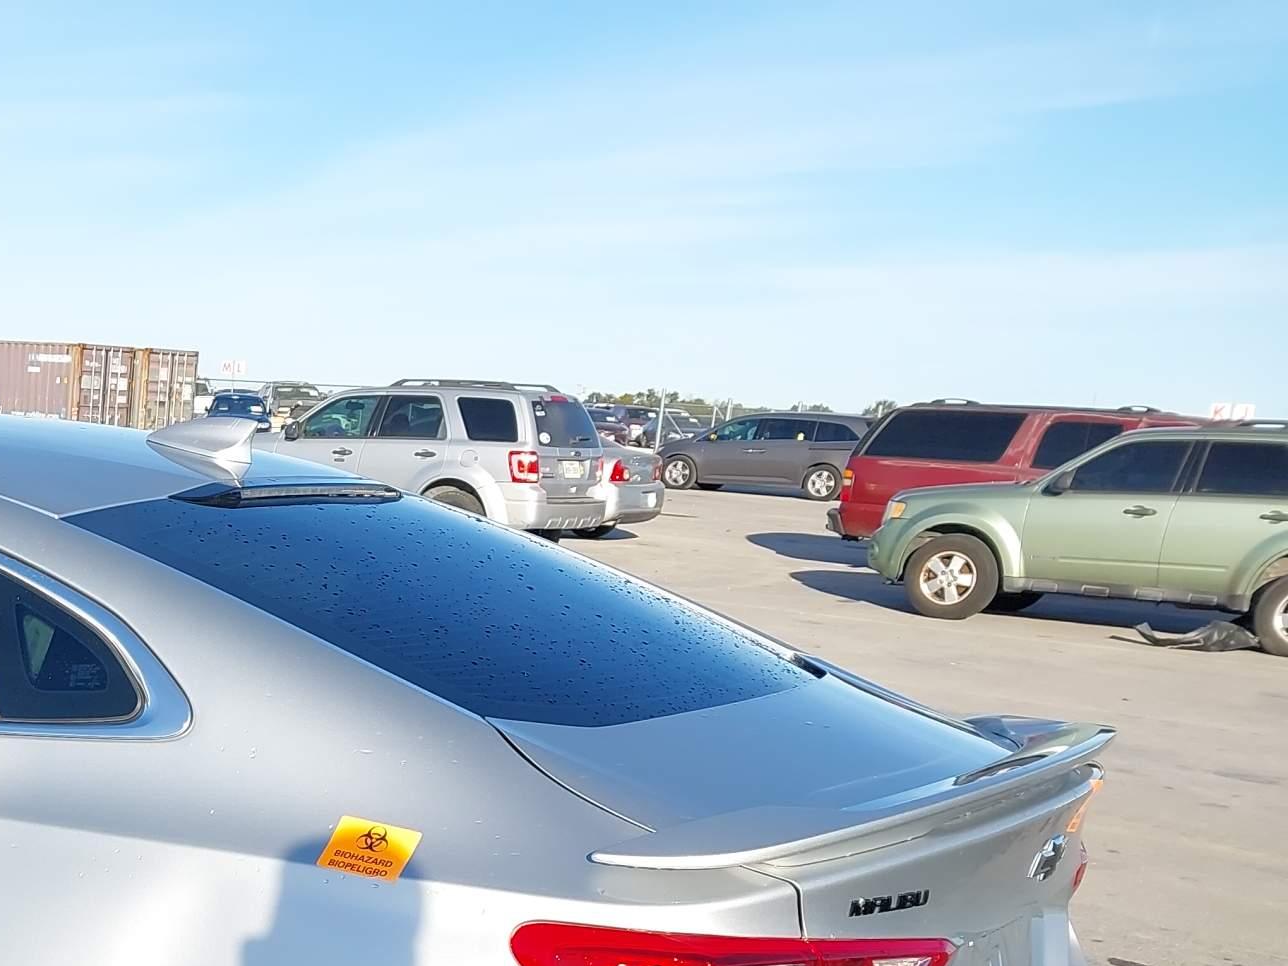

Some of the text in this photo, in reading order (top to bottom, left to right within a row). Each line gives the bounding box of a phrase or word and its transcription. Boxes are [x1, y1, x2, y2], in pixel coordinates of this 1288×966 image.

[327, 858, 388, 878] BIOPELIGRO
[333, 848, 394, 868] BIOHAZARD
[847, 889, 930, 918] MALIBU
